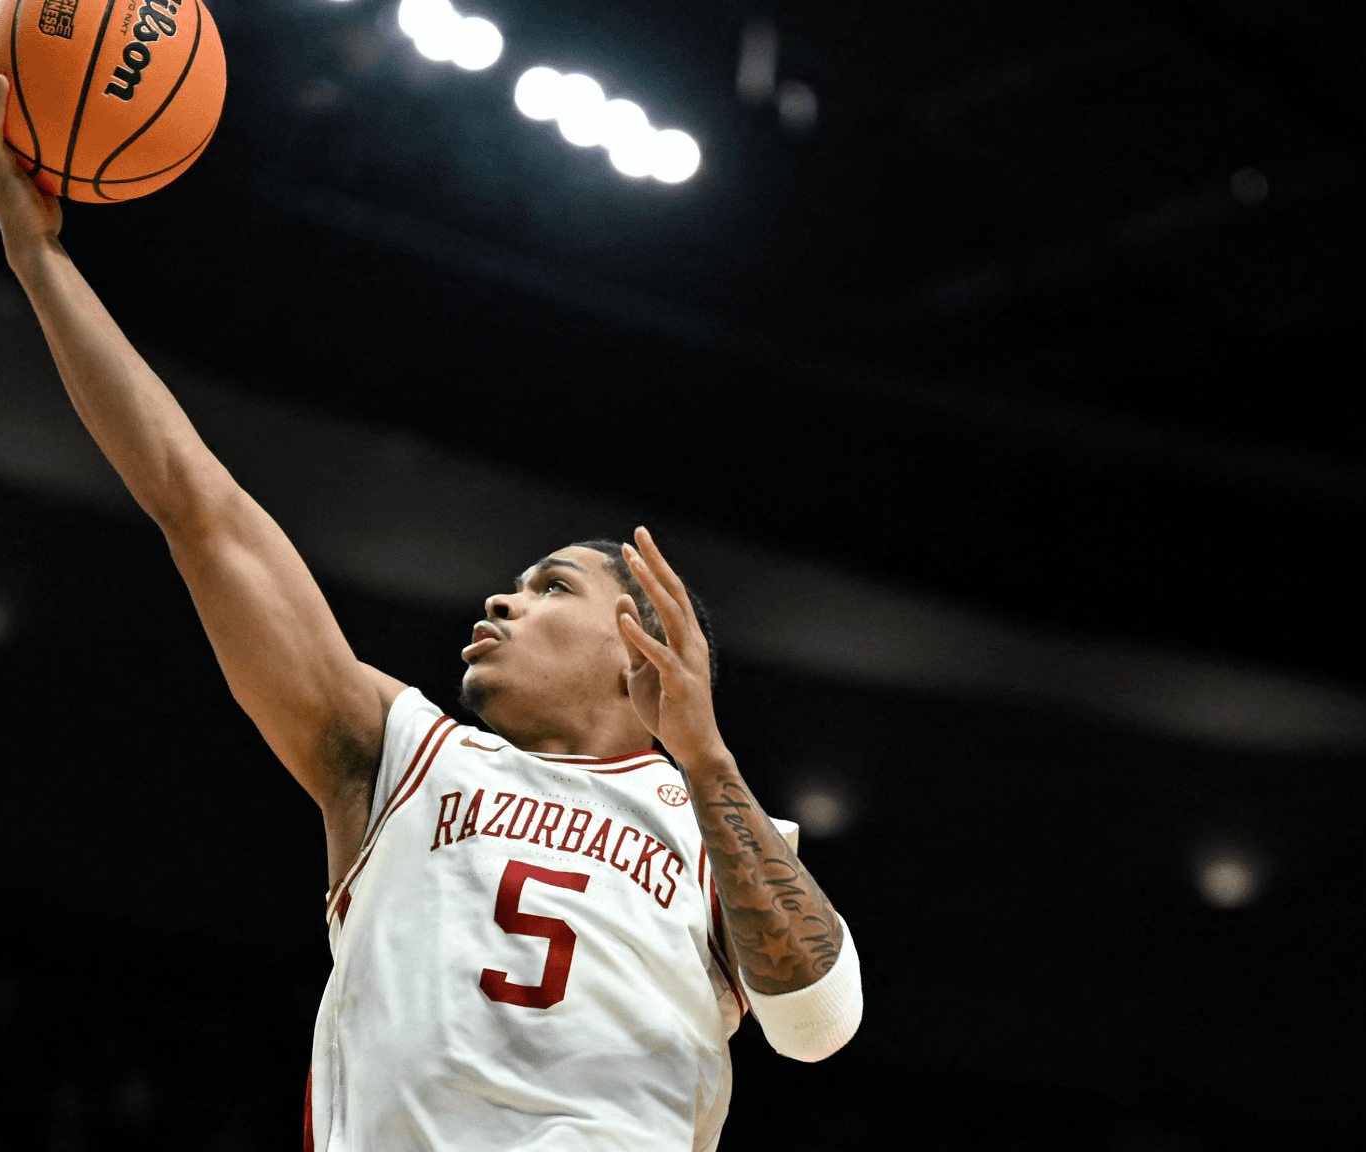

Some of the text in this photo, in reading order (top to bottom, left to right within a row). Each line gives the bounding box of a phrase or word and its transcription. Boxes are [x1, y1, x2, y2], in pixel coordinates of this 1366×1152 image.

[102, 0, 182, 102] ilson
[430, 788, 685, 910] RAZORBACKS
[660, 785, 688, 807] SEC
[479, 858, 591, 1010] 5
